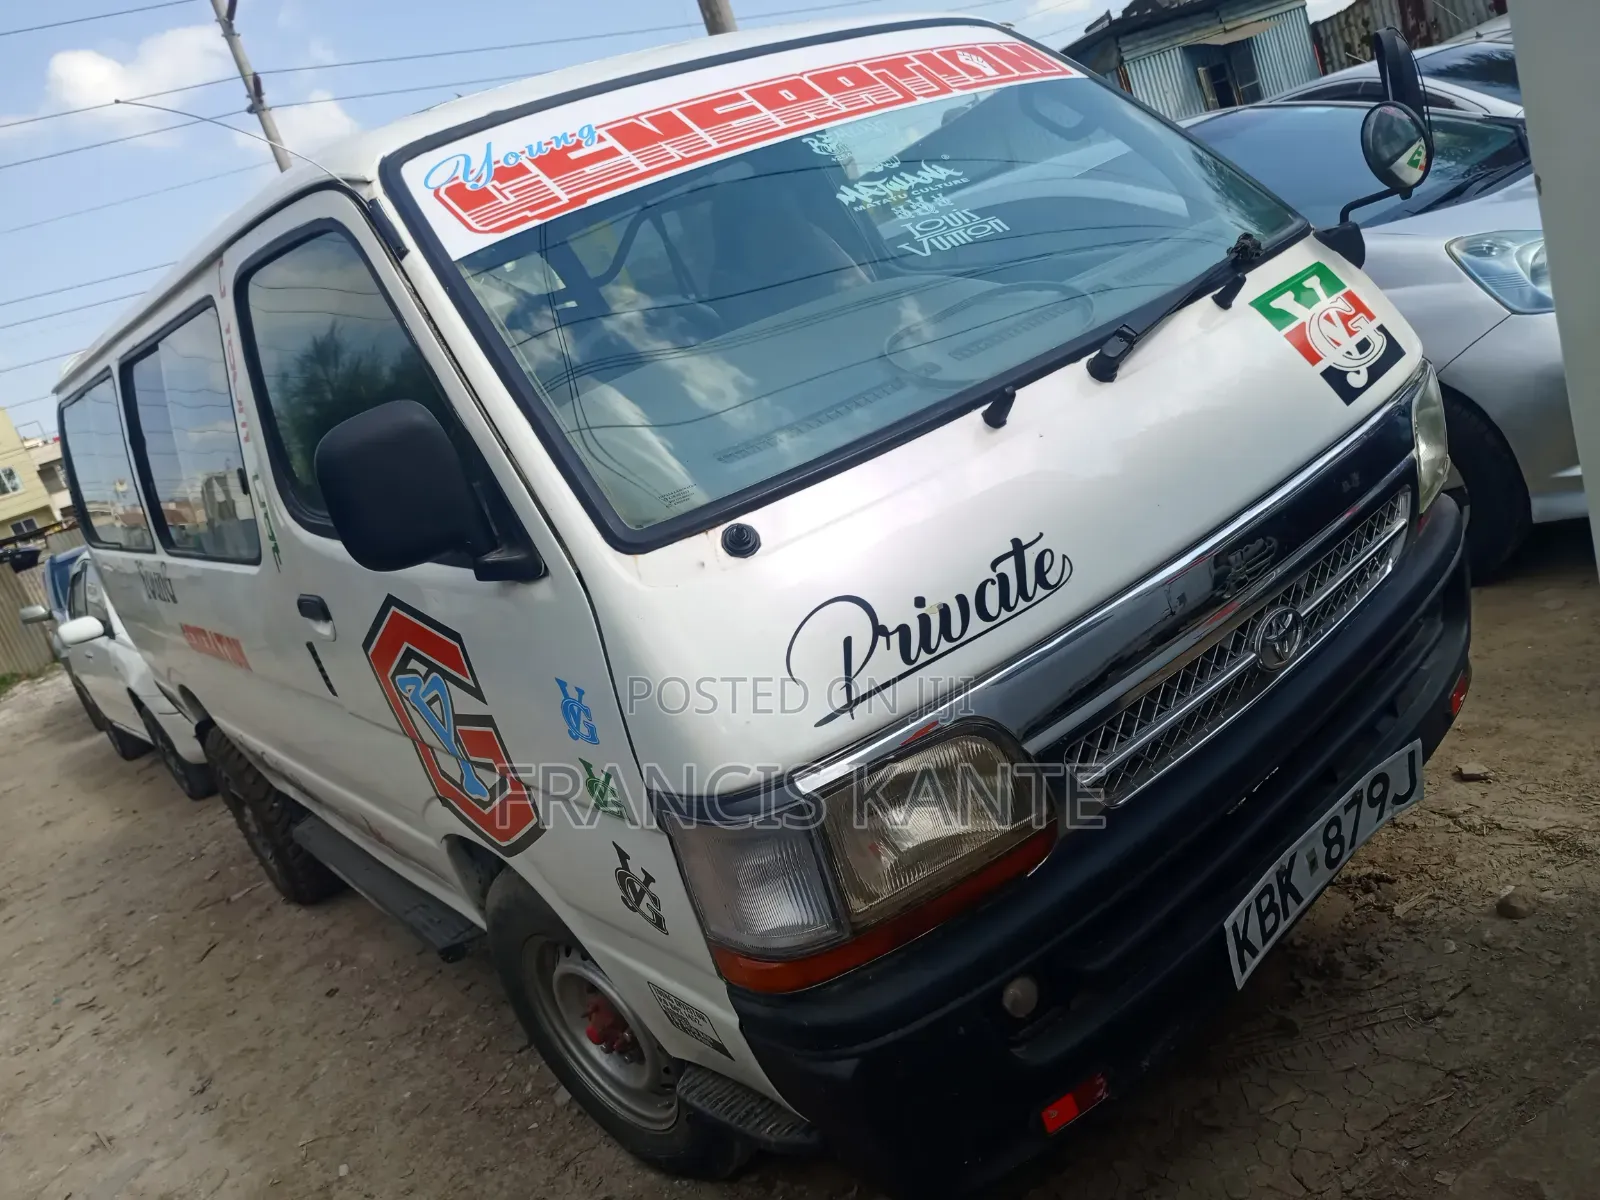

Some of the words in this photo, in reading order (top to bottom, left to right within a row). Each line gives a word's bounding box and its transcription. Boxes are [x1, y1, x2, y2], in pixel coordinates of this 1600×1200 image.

[423, 123, 598, 190] Young
[434, 42, 1073, 233] GENERATION
[853, 192, 908, 212] MATATU
[911, 177, 971, 196] CULTURE
[786, 532, 1074, 728] Private
[1231, 851, 1305, 977] KBK
[1321, 749, 1417, 870] 879J
